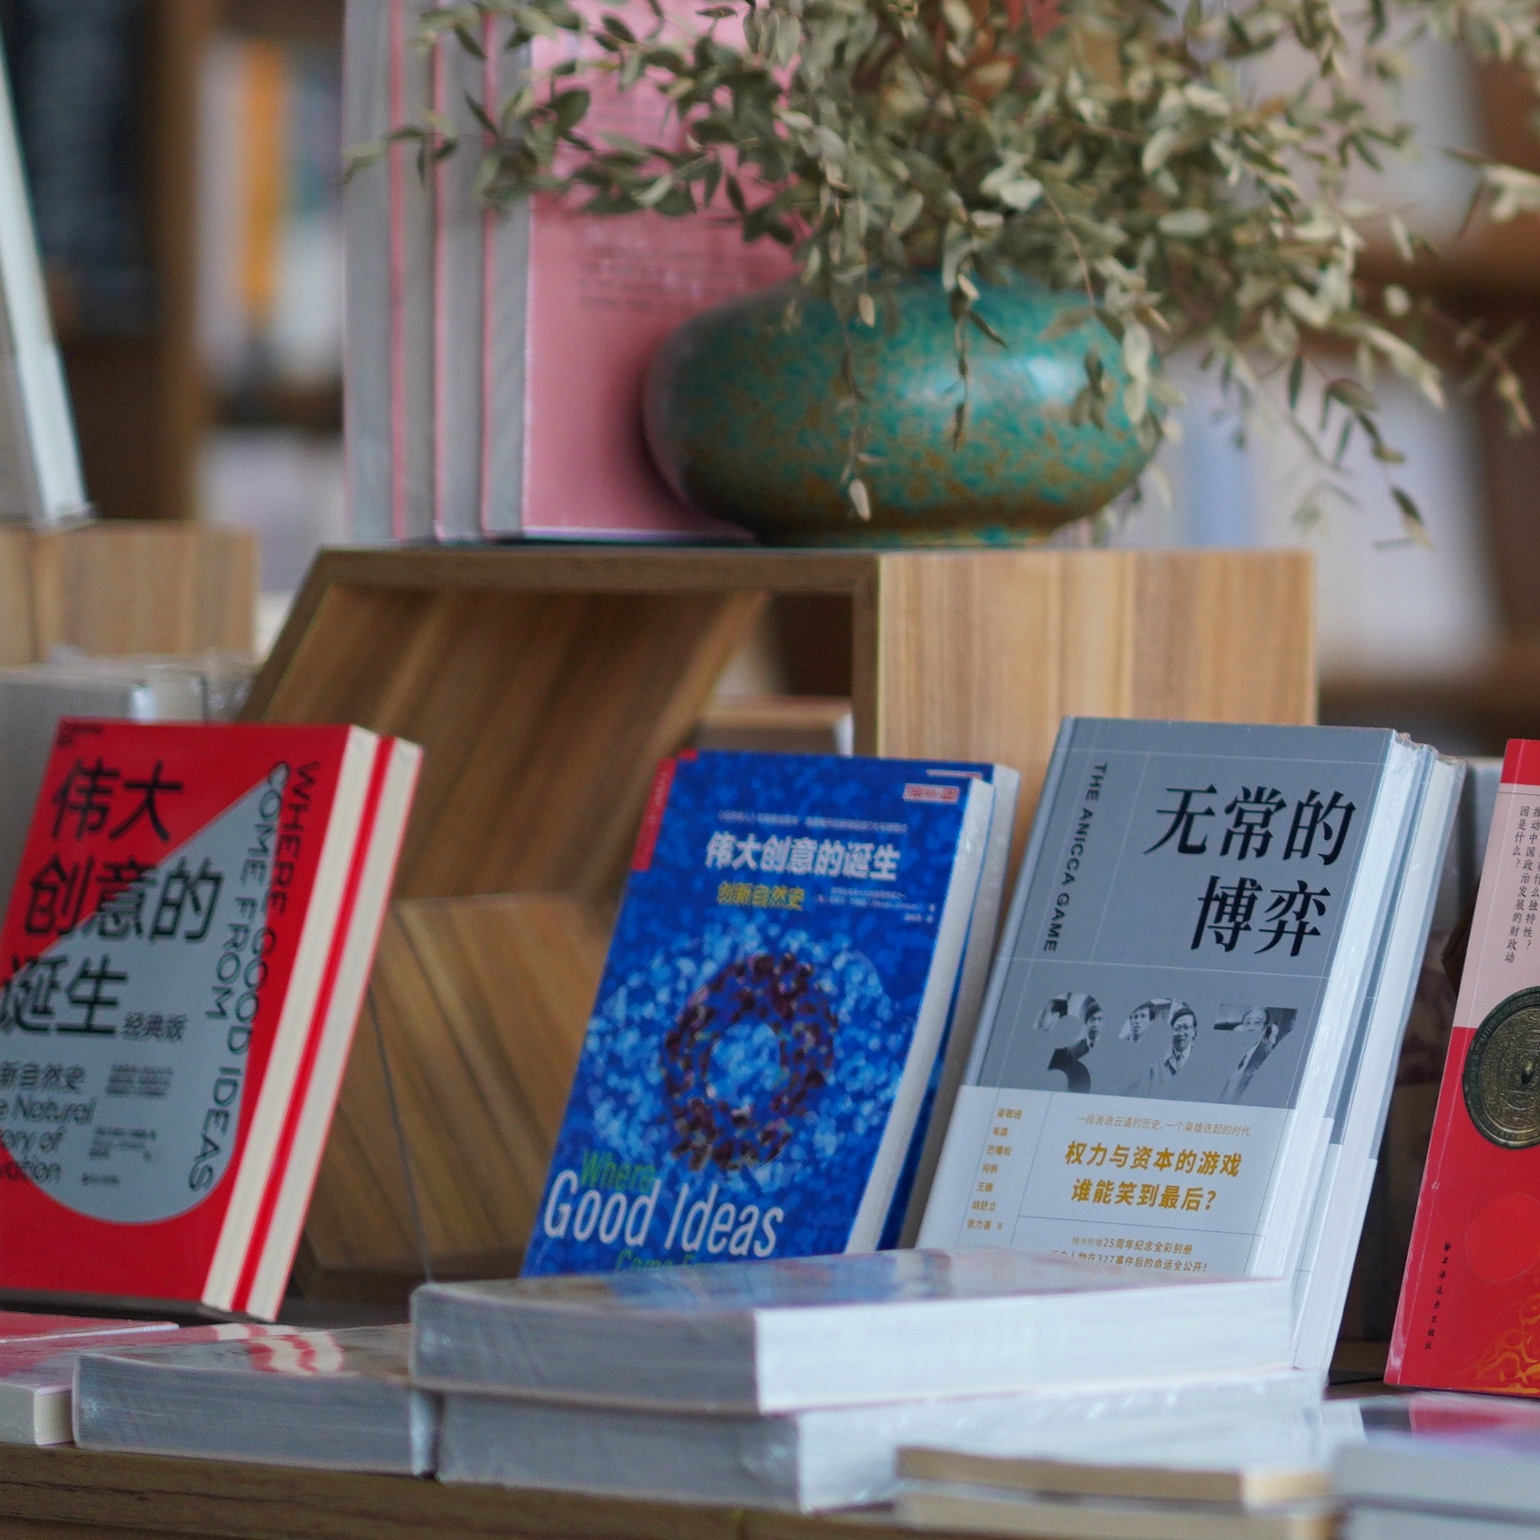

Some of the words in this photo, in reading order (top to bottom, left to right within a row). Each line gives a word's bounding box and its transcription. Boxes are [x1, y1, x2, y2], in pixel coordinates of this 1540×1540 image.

[50, 758, 183, 844] 伟大
[1085, 761, 1108, 802] THE
[240, 761, 290, 886] COME
[267, 761, 320, 915] WHERE
[705, 831, 902, 882] 伟大创意的诞生
[1061, 807, 1094, 885] ANICCA
[1143, 783, 1356, 866] 无常的
[1512, 805, 1530, 870] 因是什么？
[24, 854, 224, 943] 创意的
[716, 880, 805, 911] 创新自然史
[1043, 891, 1071, 953] GAME
[1189, 875, 1331, 957] 博弈
[206, 896, 257, 1021] FROM
[227, 926, 279, 1054] GOOD
[188, 1066, 242, 1191] IDEAS
[1064, 1140, 1242, 1178] 权力与资本的游戏
[543, 1168, 661, 1248] Good
[663, 1181, 785, 1257] Ideas
[579, 1148, 656, 1195] Where
[1071, 1178, 1218, 1213] 谁能笑到最后？
